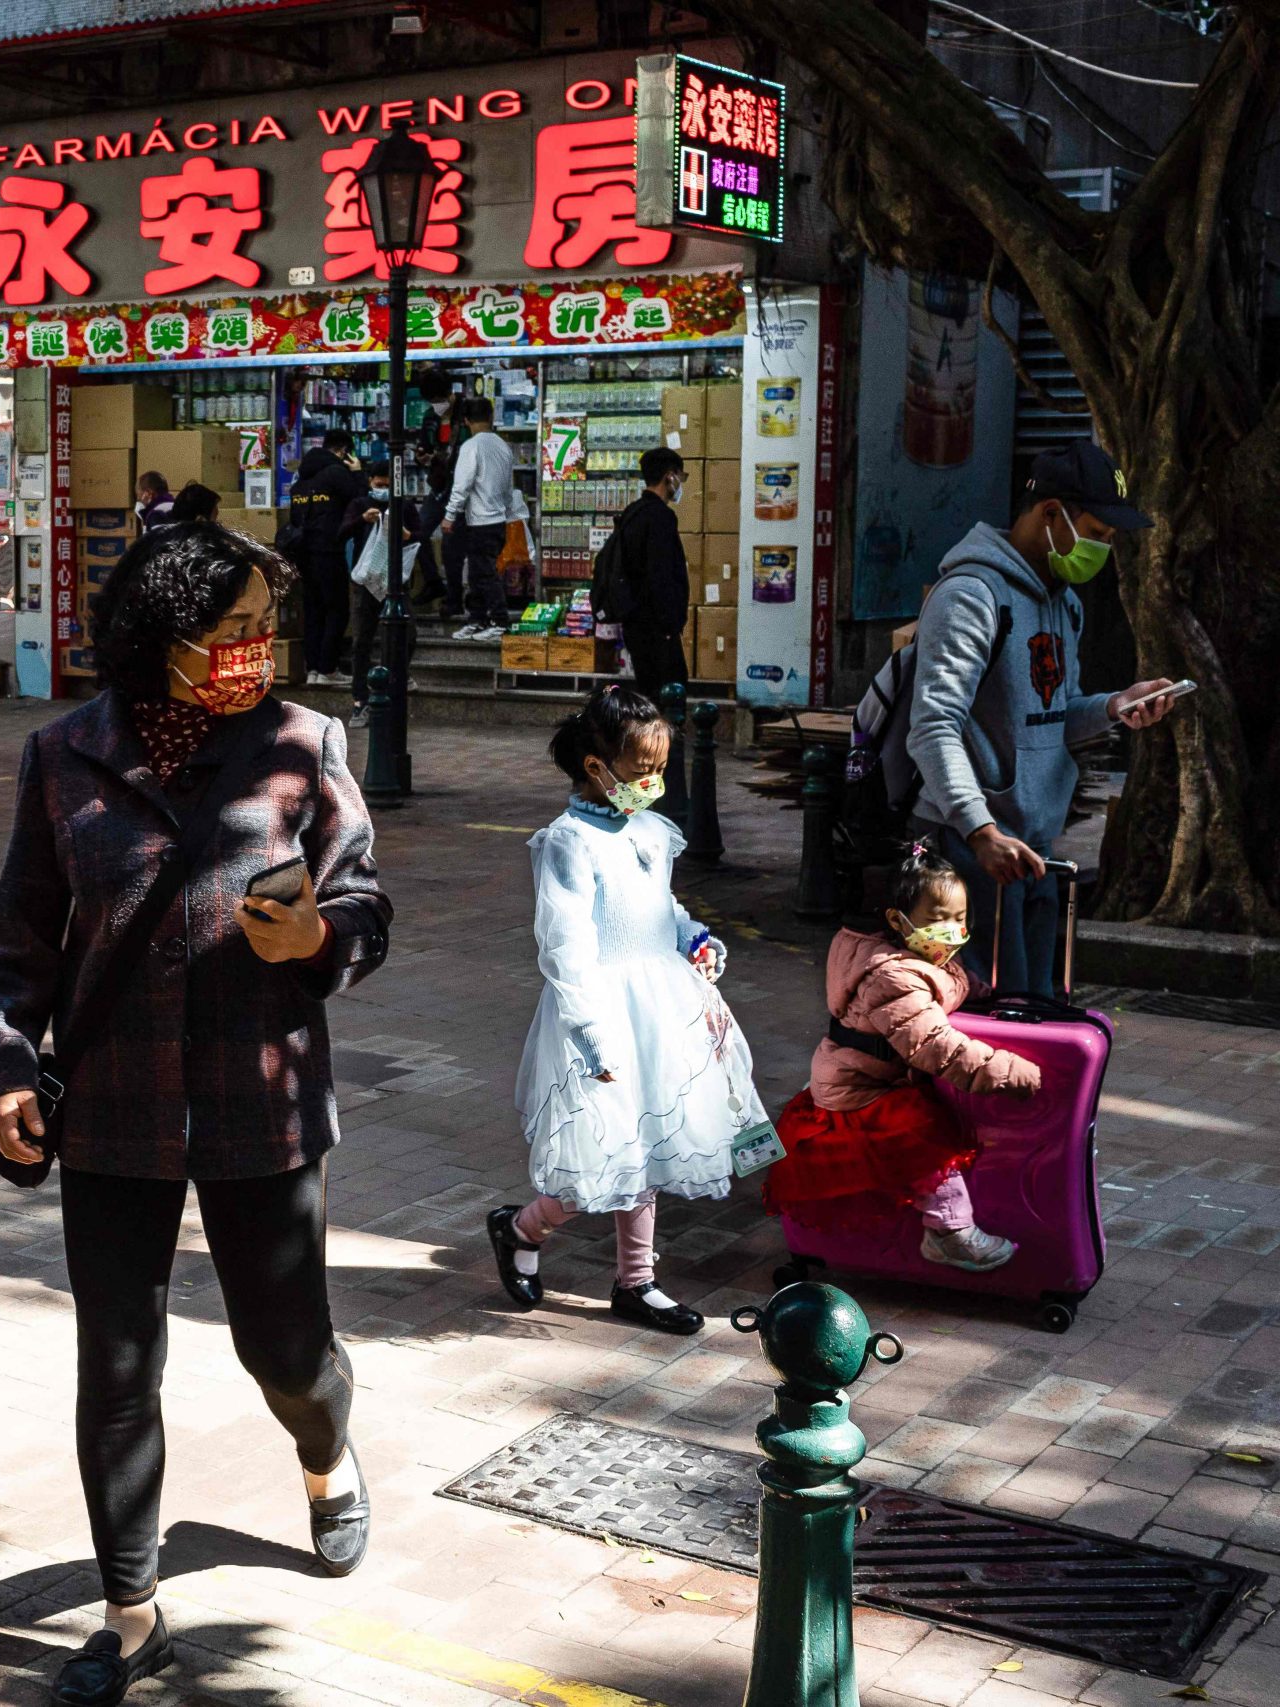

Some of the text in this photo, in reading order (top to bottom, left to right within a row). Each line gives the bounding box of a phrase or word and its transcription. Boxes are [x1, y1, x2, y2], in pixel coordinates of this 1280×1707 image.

[317, 90, 523, 136] WENG
[681, 73, 777, 158] 永安藥房
[53, 384, 70, 488] 政府註冊
[552, 427, 578, 471] 7
